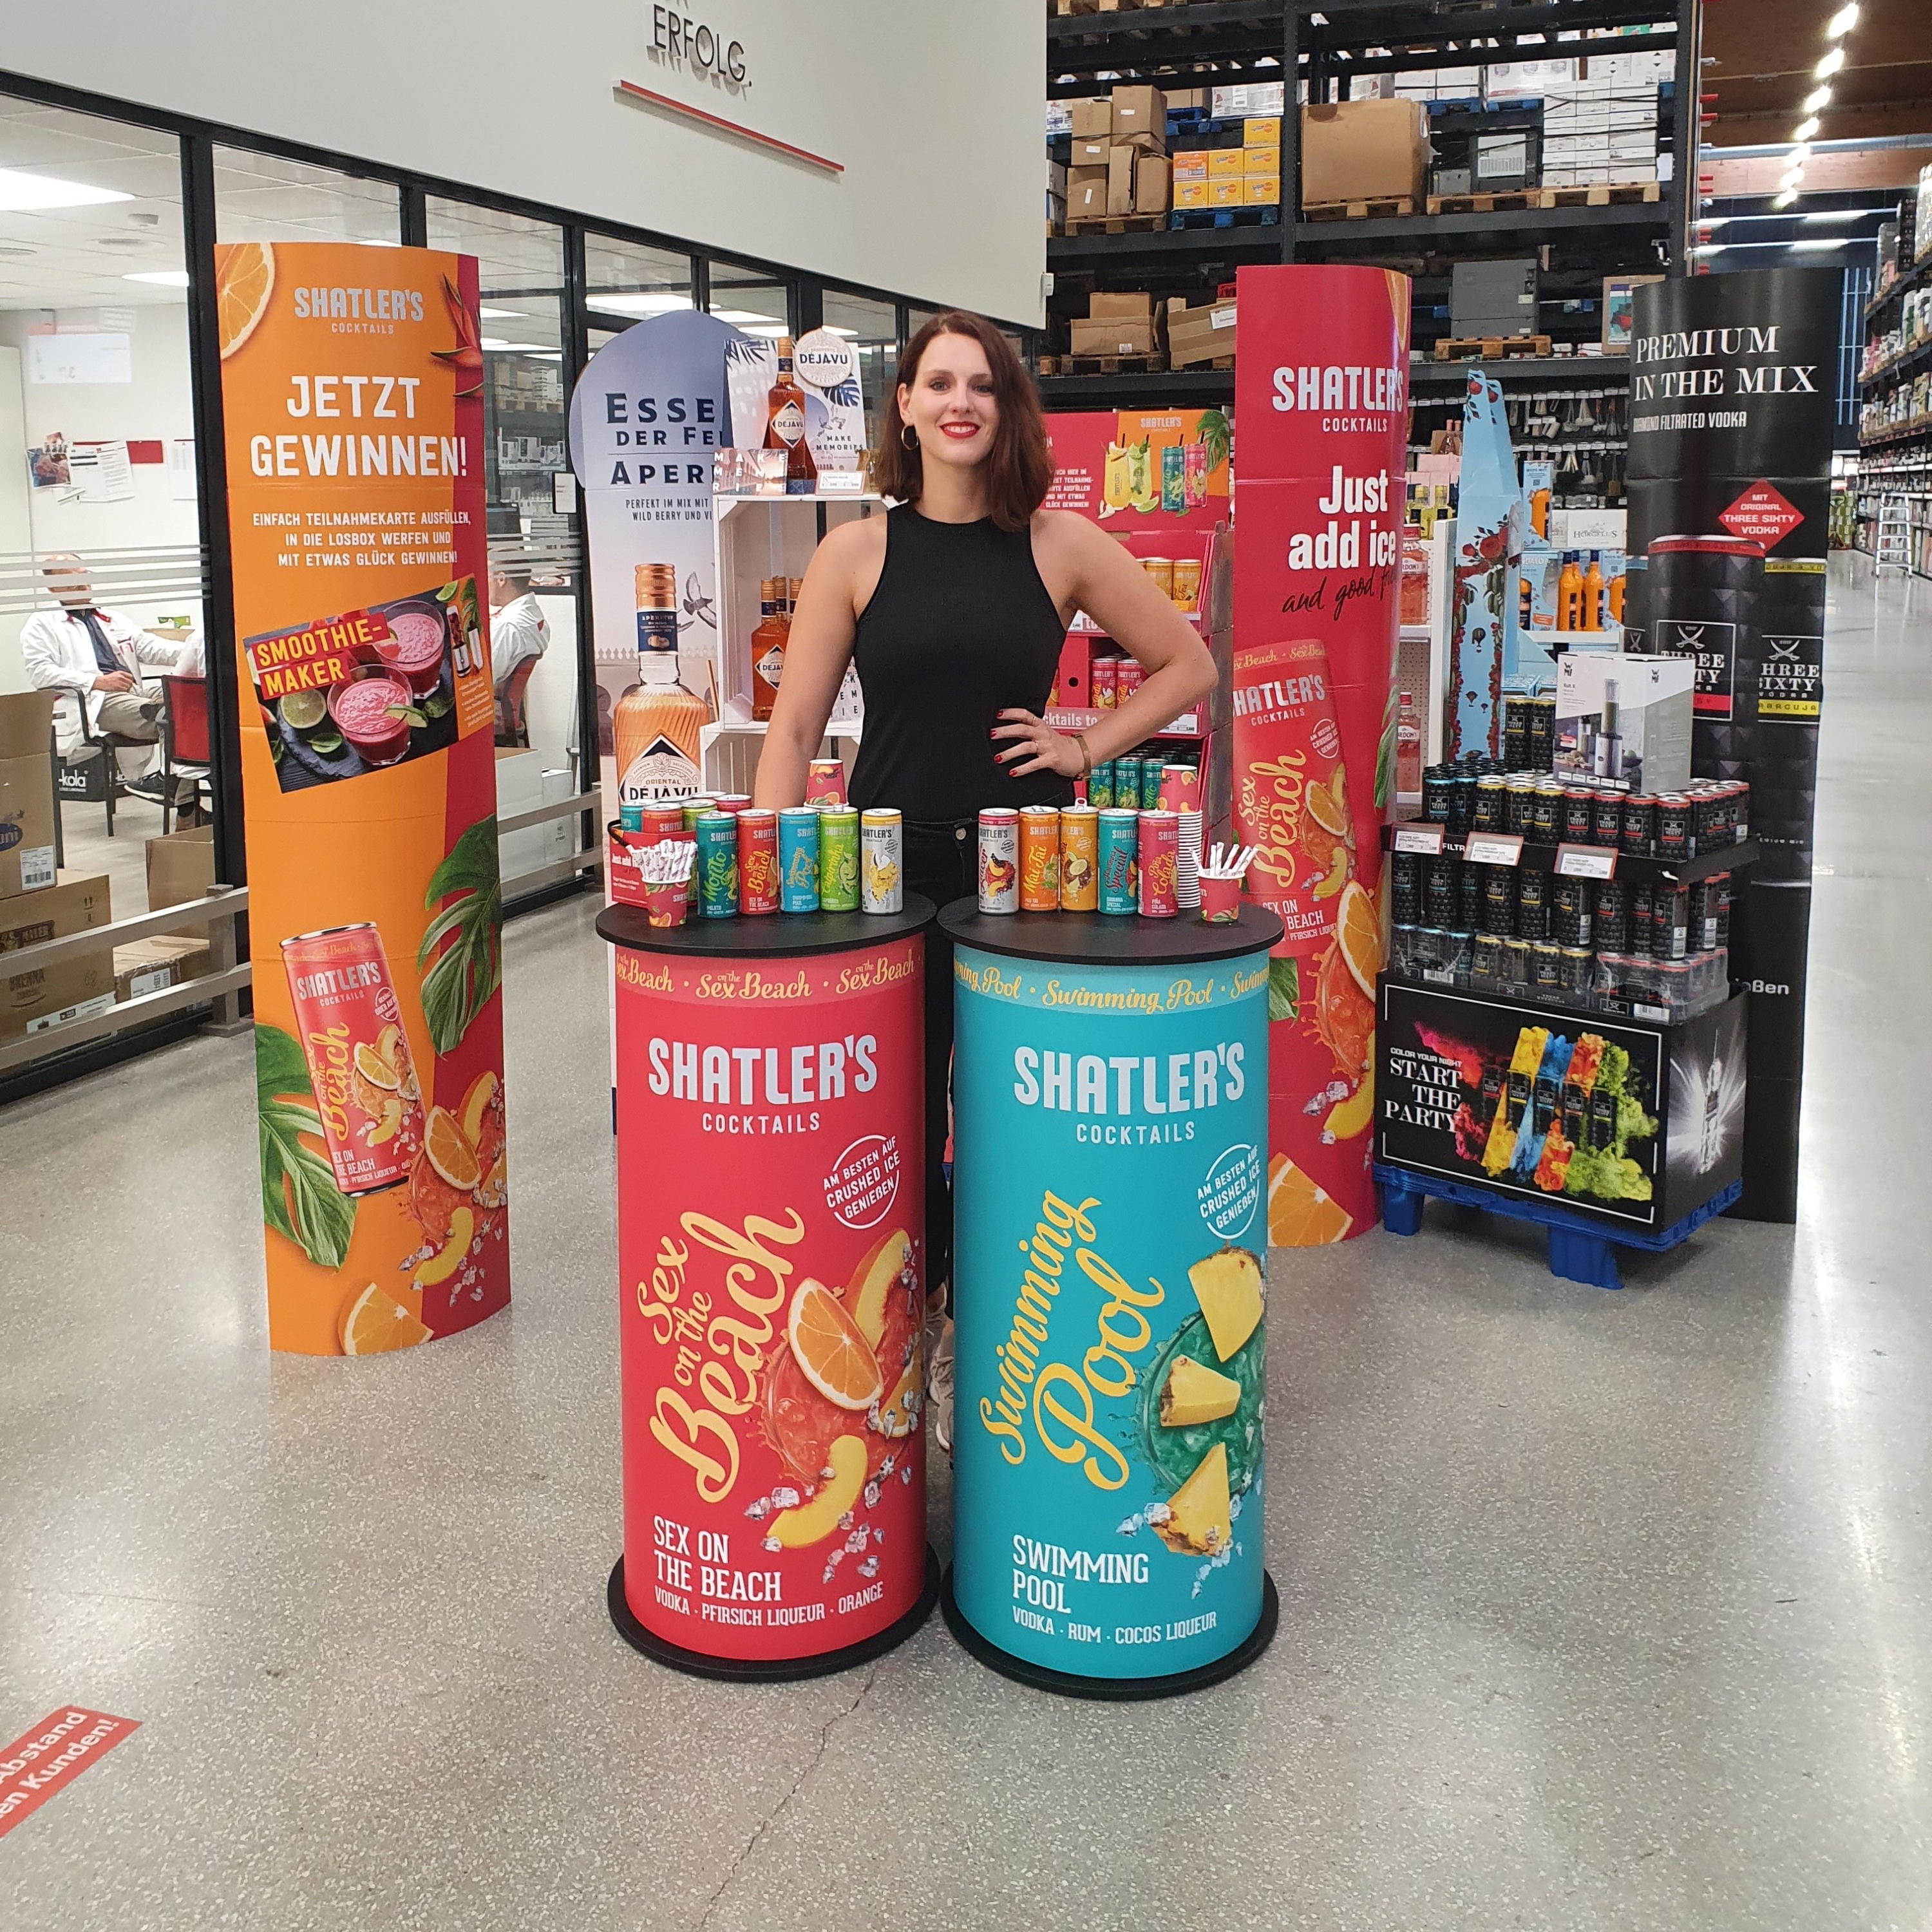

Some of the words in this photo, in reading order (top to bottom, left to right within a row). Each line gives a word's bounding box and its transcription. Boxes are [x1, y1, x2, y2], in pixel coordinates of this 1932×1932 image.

[653, 4, 752, 87] ERFOLG.
[294, 287, 424, 321] SHATLER'S
[331, 323, 394, 334] COCKTAILS
[1635, 326, 1781, 364] PREMIUM
[287, 375, 420, 419] JETZT
[1634, 375, 1654, 401] IN
[1661, 368, 1724, 399] THE
[1735, 365, 1819, 394] MIX
[616, 430, 667, 446] DER
[1322, 417, 1387, 433] COCKTAILS
[1661, 413, 1705, 430] FILTRATED
[1709, 412, 1747, 428] VODKA
[251, 435, 467, 477] GEWINNEN!
[626, 498, 659, 509] PERFEKT
[663, 498, 673, 508] IM
[676, 498, 691, 508] MIX
[694, 498, 708, 508] MIT
[1320, 466, 1388, 514] Just
[253, 513, 300, 526] EINFACH
[306, 513, 415, 526] TEILNAHMEKARTE
[421, 509, 471, 526] AUSFÜLLEN,
[632, 511, 652, 521] WILD
[656, 511, 681, 521] BERRY
[685, 511, 701, 521] UND
[1741, 526, 1779, 535] VODKA
[1762, 515, 1795, 523] SIXTY
[286, 534, 297, 545] IN
[303, 534, 323, 545] DIE
[329, 533, 375, 545] LOSBOX
[382, 533, 428, 544] WERFEN
[433, 532, 450, 544] UND
[1288, 520, 1359, 570] add
[1369, 520, 1396, 567] ice
[278, 554, 299, 566] MIT
[306, 554, 350, 566] ETWAS
[357, 550, 395, 565] GLÜCK
[401, 551, 457, 565] GEWINNEN!
[1282, 576, 1327, 613] and
[1334, 565, 1376, 621] good
[257, 619, 382, 667] SMOOTHIE-
[1244, 649, 1278, 668] Beach
[265, 658, 345, 696] MAKER
[1761, 663, 1820, 677] HREE
[1233, 674, 1325, 717] HATLER'S
[1251, 708, 1305, 726] COCKTAILS
[1238, 776, 1256, 827] Sex
[1249, 749, 1307, 888] Beach
[1256, 795, 1271, 821] the
[1258, 822, 1269, 840] on
[747, 848, 772, 894] Beach
[1151, 849, 1176, 896] Colada
[1283, 898, 1298, 914] ON
[1287, 909, 1324, 931] BEACH
[1290, 928, 1318, 941] PFIRSICH
[297, 961, 381, 1000] SHATLER'S
[628, 957, 675, 992] Beach
[728, 971, 741, 983] the
[836, 969, 871, 994] Sex
[873, 950, 914, 985] Beach
[864, 960, 875, 972] the
[982, 967, 1022, 999] Pool
[319, 990, 365, 1007] COCKTAILS
[696, 973, 736, 999] Sex
[739, 971, 812, 999] Beach
[1041, 980, 1164, 1015] Swimming
[1166, 978, 1214, 1010] Pool
[648, 1034, 878, 1106] SHATLER'S
[1390, 1047, 1416, 1058] COLOR
[1417, 1052, 1437, 1063] YOUR
[1390, 1057, 1463, 1088] START
[308, 1021, 350, 1141] Beach
[1014, 1042, 1245, 1115] SHATLER'S
[1385, 1099, 1457, 1133] PARTY
[1412, 1084, 1461, 1112] THE
[702, 1112, 820, 1135] COCKTAILS
[1076, 1121, 1195, 1145] COCKTAILS
[347, 1158, 375, 1175] BEACH
[823, 1173, 840, 1191] AM
[842, 1153, 880, 1180] BESTEN
[882, 1135, 896, 1157] AUF
[826, 1168, 880, 1209] CRUSHED
[884, 1150, 900, 1172] ICE
[1197, 1184, 1211, 1200] AM
[1215, 1159, 1245, 1190] BESTEN
[1247, 1144, 1258, 1166] AUF
[1199, 1176, 1247, 1219] CRUSHED
[1249, 1160, 1260, 1182] ICE
[637, 1235, 688, 1345] Sex
[675, 1291, 714, 1350] the
[978, 1189, 1101, 1465] Swimming
[649, 1207, 806, 1504] Beach
[674, 1350, 697, 1387] on
[1033, 1247, 1164, 1490] Pool
[654, 1515, 690, 1554] SEX
[698, 1530, 730, 1564] ON
[654, 1549, 693, 1592] THE
[701, 1567, 782, 1602] BEACH
[1012, 1533, 1149, 1584] SWIMMING
[654, 1584, 690, 1616] VODKA
[701, 1604, 762, 1627] PFIRSICH
[766, 1605, 826, 1627] LIQUEUR
[838, 1582, 884, 1615] ORANGE
[1012, 1569, 1072, 1615] POOL
[1012, 1606, 1055, 1636] VODKA
[1068, 1620, 1101, 1643] RUM
[1115, 1622, 1162, 1645] COCOS
[1166, 1611, 1217, 1642] LIQUEUR
[19, 1719, 120, 1790] Kunden!
